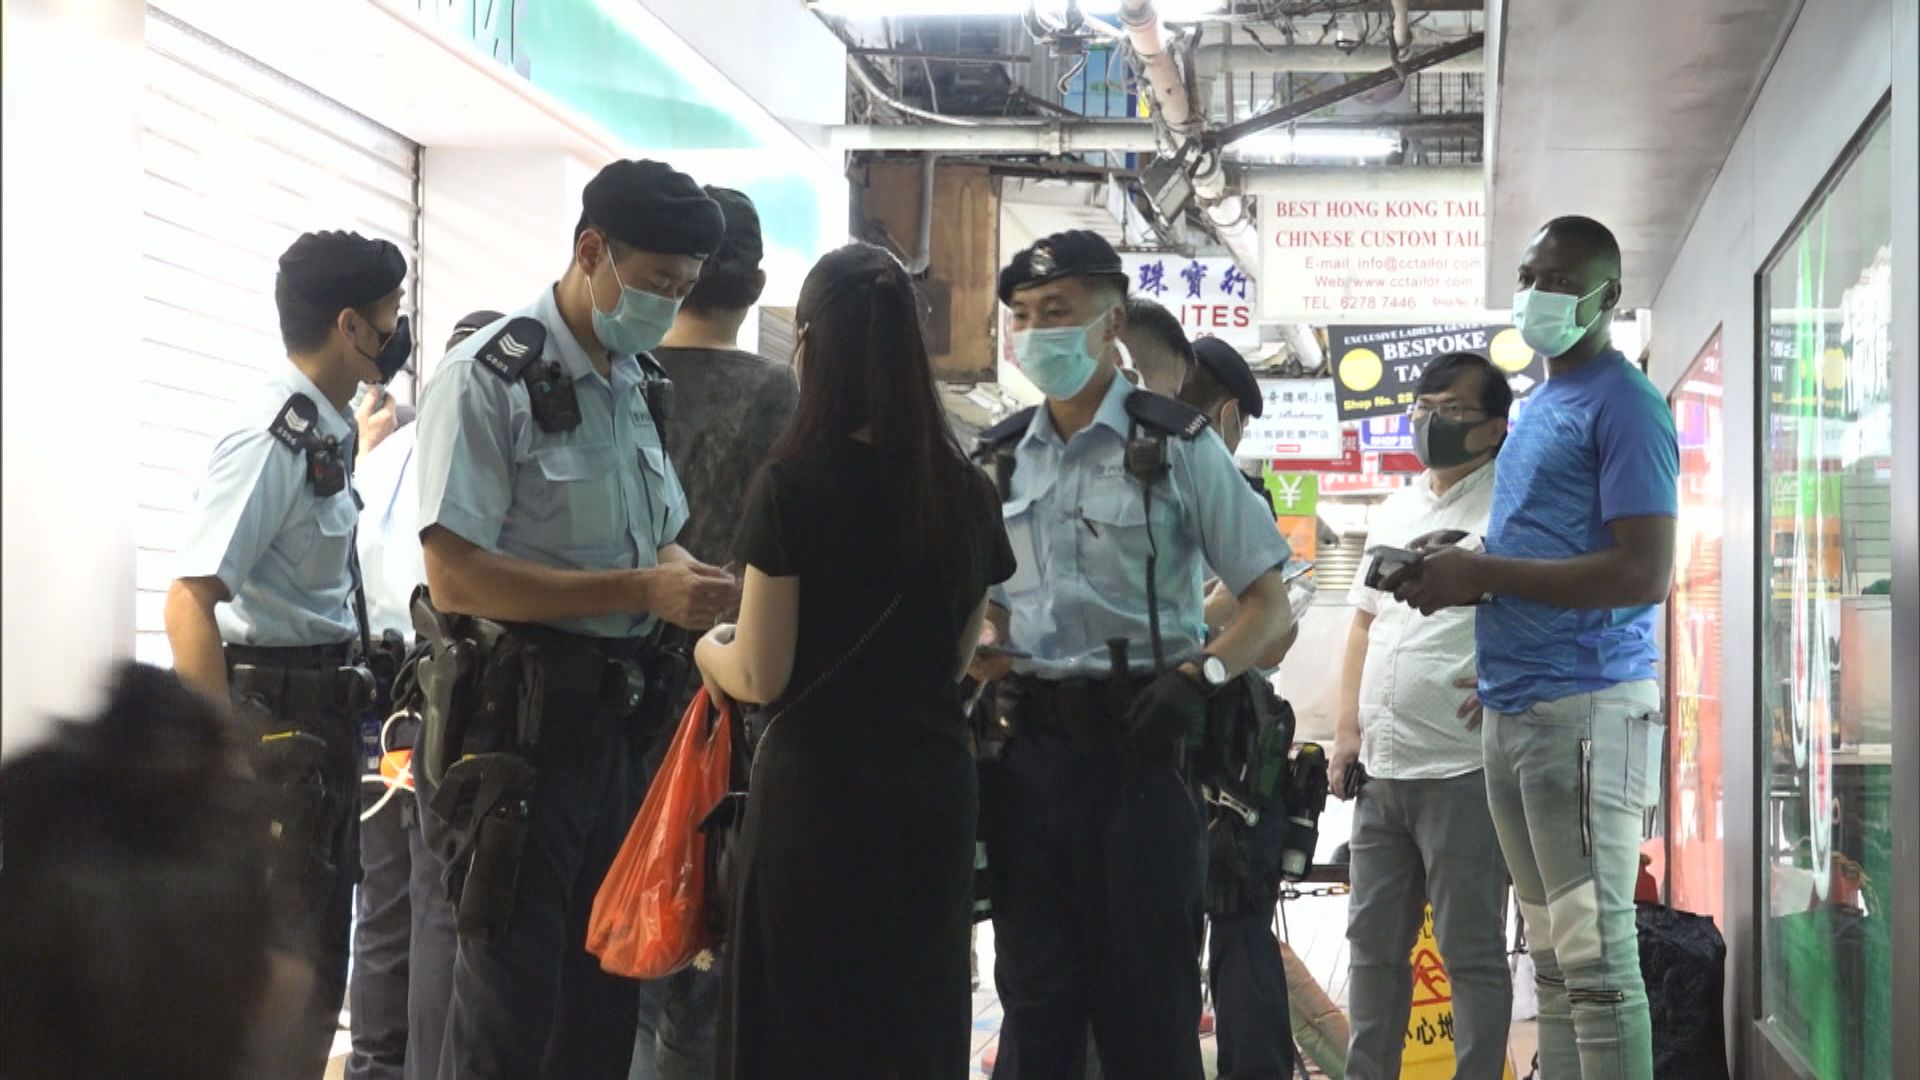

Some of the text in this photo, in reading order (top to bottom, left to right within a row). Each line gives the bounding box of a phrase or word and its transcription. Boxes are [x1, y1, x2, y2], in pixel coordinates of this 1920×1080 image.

[1276, 201, 1319, 218] BEST
[1327, 201, 1378, 218] HONG
[1386, 201, 1438, 218] KONG
[1276, 230, 1354, 248] CHINESE
[1361, 230, 1437, 248] CUSTOM
[1139, 260, 1246, 299] 珠寶行
[1340, 296, 1376, 310] 6278
[1381, 296, 1417, 310] 7446
[1344, 329, 1398, 345] EXCLUSIVE
[1399, 325, 1434, 338] LADIES
[1435, 324, 1443, 334] &
[1382, 331, 1487, 361] BESPOKE
[1394, 362, 1428, 384] TA
[1343, 399, 1372, 411] Shop
[1374, 396, 1395, 407] No.
